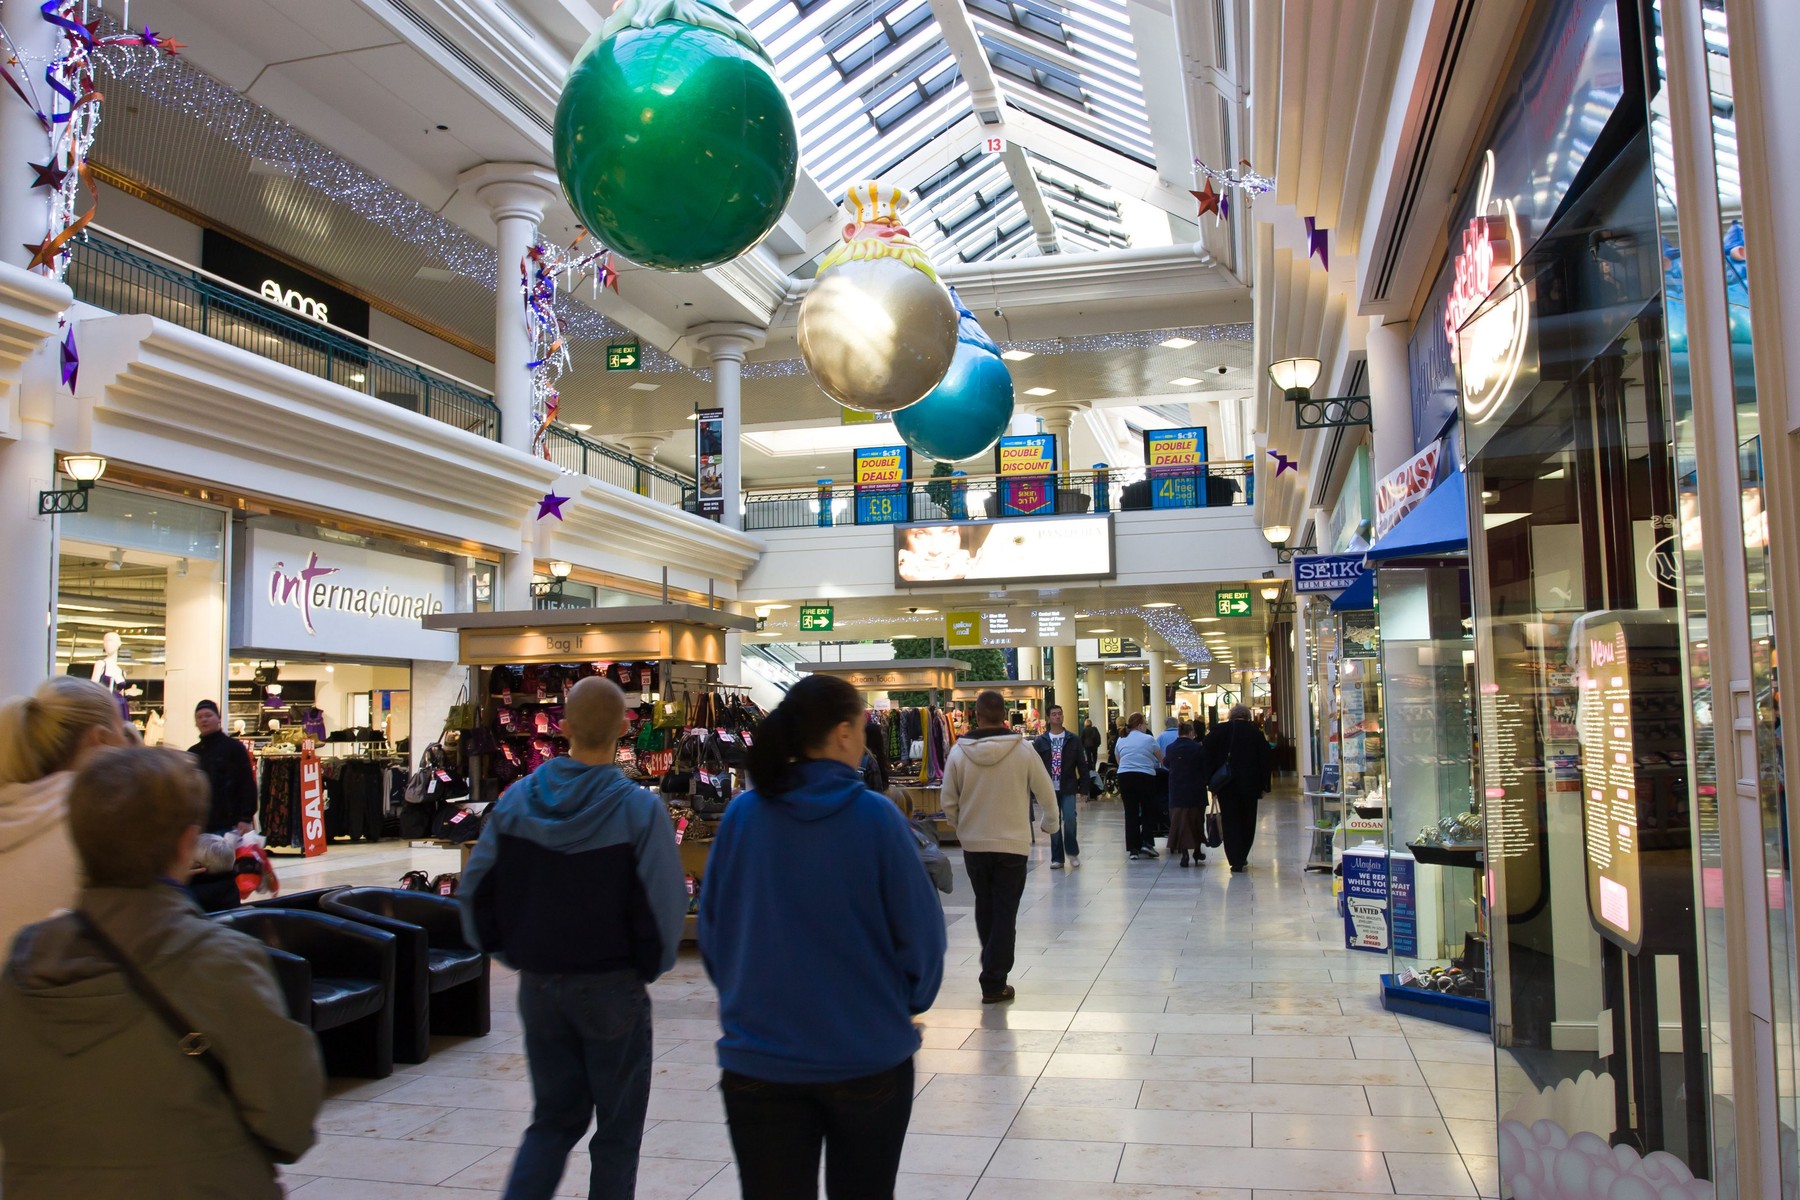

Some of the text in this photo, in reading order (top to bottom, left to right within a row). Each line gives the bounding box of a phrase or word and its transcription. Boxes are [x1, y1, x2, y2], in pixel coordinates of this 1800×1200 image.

[987, 138, 1001, 151] 13
[1155, 441, 1192, 451] DOUBLE
[1003, 448, 1039, 458] DOUBLE
[861, 458, 896, 468] DOUBLE
[1156, 454, 1195, 465] DEALS!
[1002, 461, 1050, 471] DISCOUNT
[861, 471, 898, 482] DEALS!
[1159, 479, 1175, 500] 4
[869, 498, 892, 515] £8
[1299, 561, 1364, 579] SEIKO
[268, 551, 443, 636] internaçionale
[952, 621, 973, 629] yellow
[546, 635, 583, 653] Bag It
[1590, 639, 1614, 668] Menu
[851, 674, 896, 683] Dream Touch
[651, 753, 673, 771] £11.99
[303, 762, 323, 840] SALE
[1351, 857, 1381, 871] Mayfair
[1347, 878, 1371, 886] WHILE
[1359, 872, 1398, 882] WE REPR
[1361, 887, 1387, 895] COLLECT
[1353, 905, 1379, 915] WANTED
